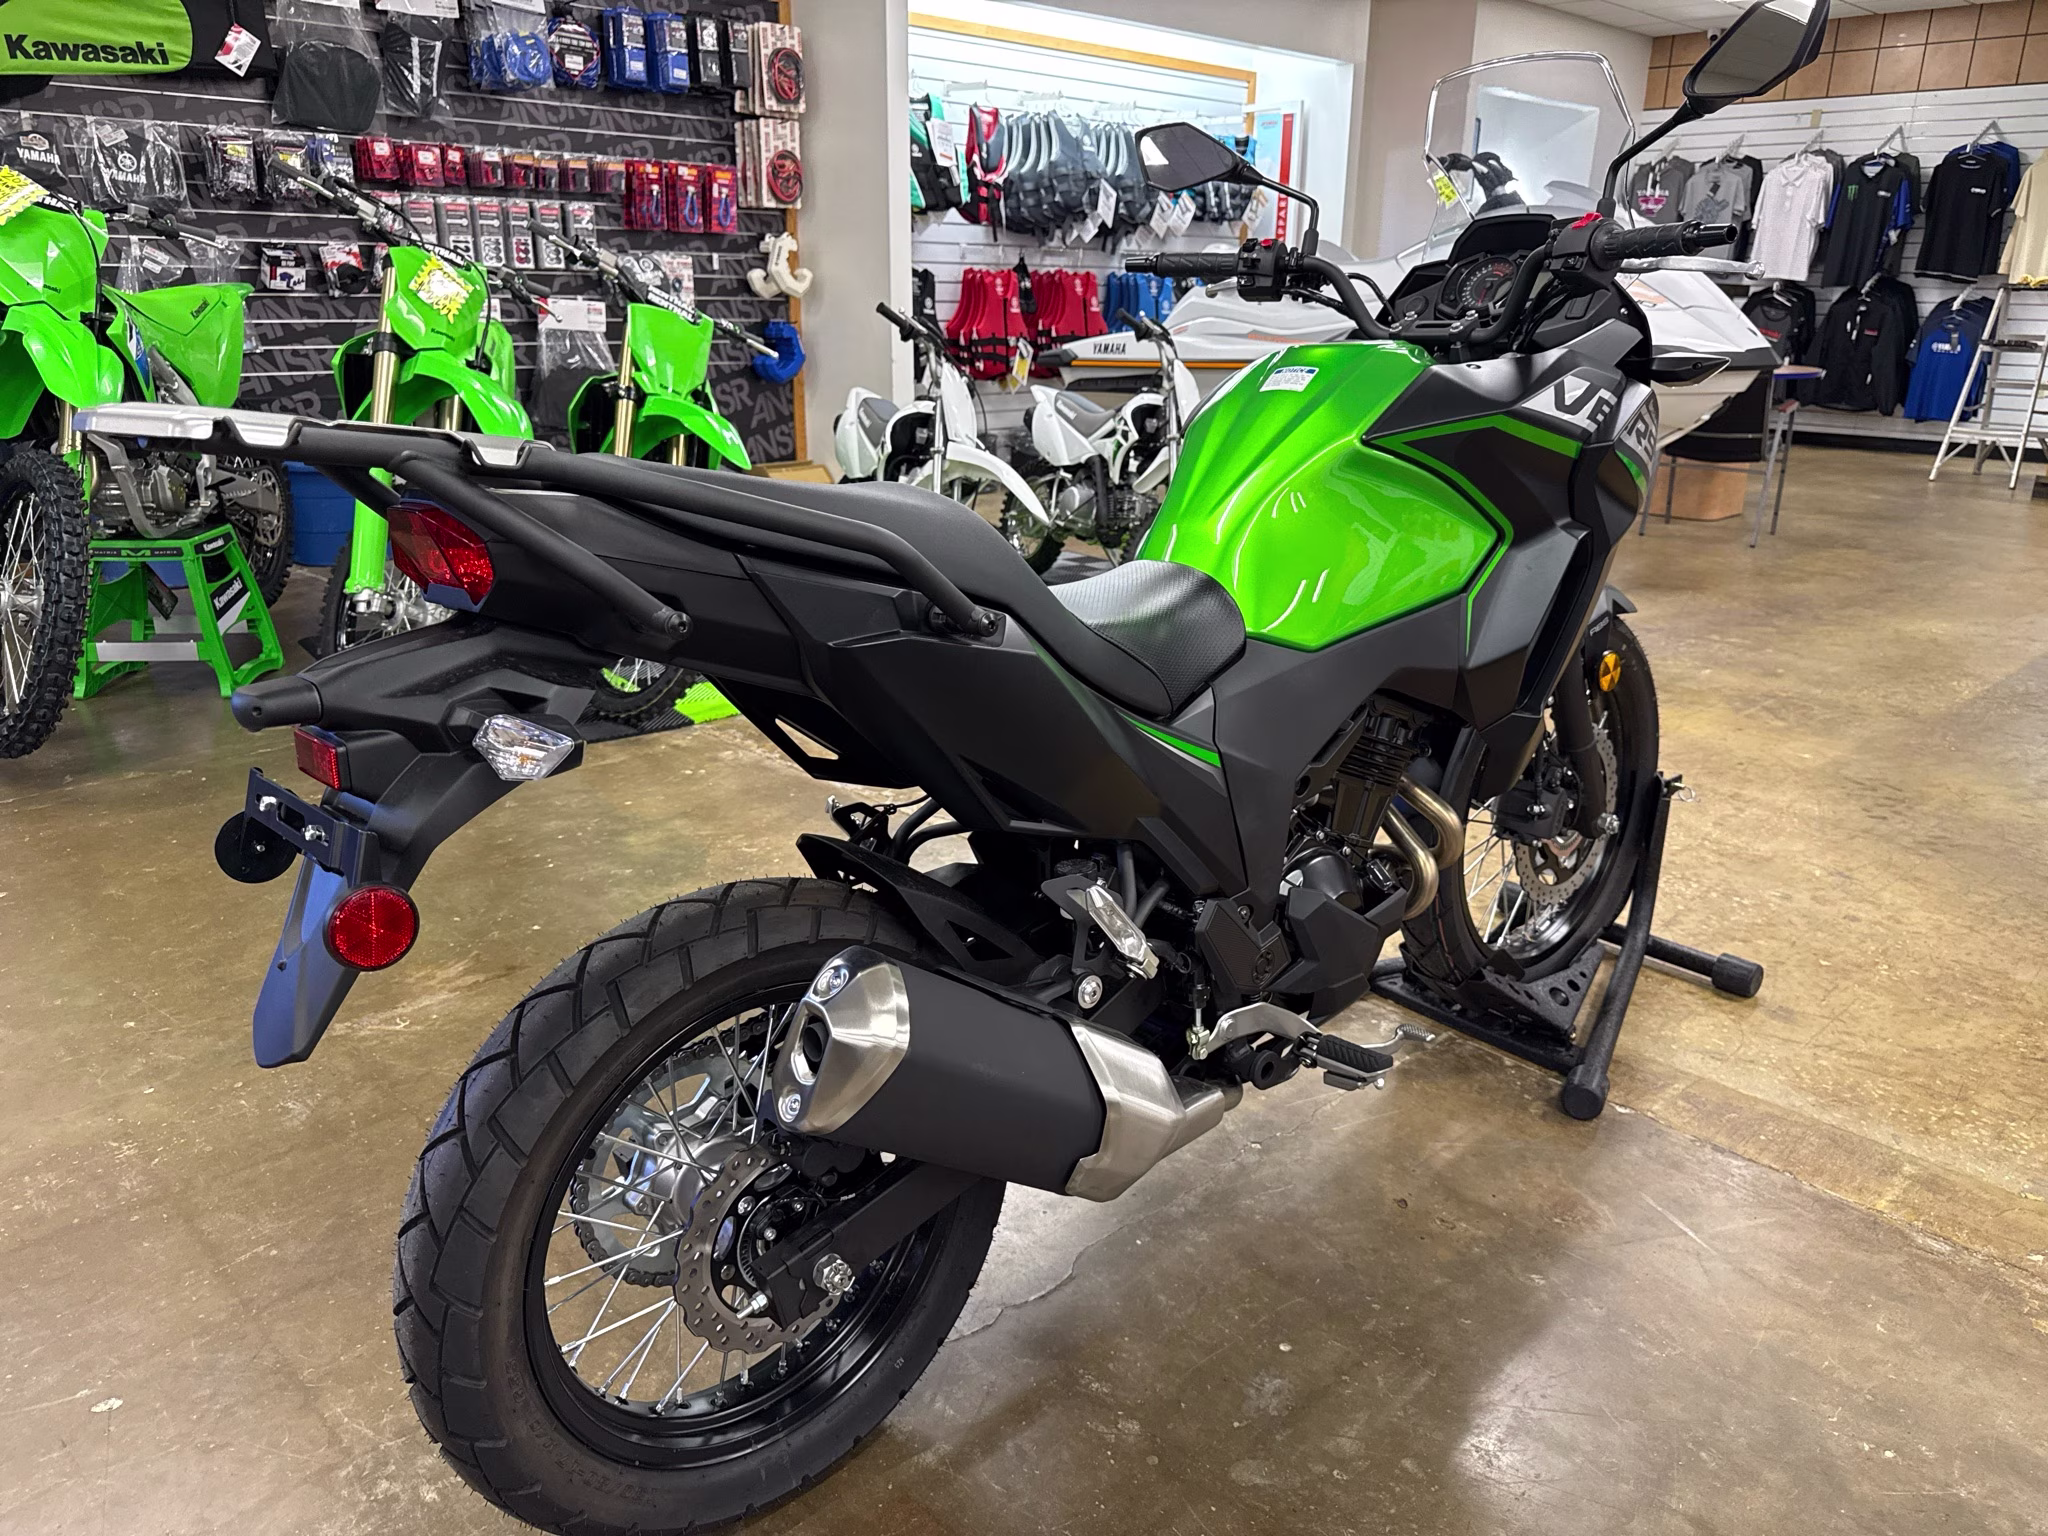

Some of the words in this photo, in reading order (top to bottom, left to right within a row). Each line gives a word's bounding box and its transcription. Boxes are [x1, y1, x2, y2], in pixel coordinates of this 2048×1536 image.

[4, 34, 169, 65] Kawasaki
[16, 147, 61, 166] YAMAHA
[1093, 342, 1126, 355] YAMAHA
[213, 577, 243, 611] Kawasaki
